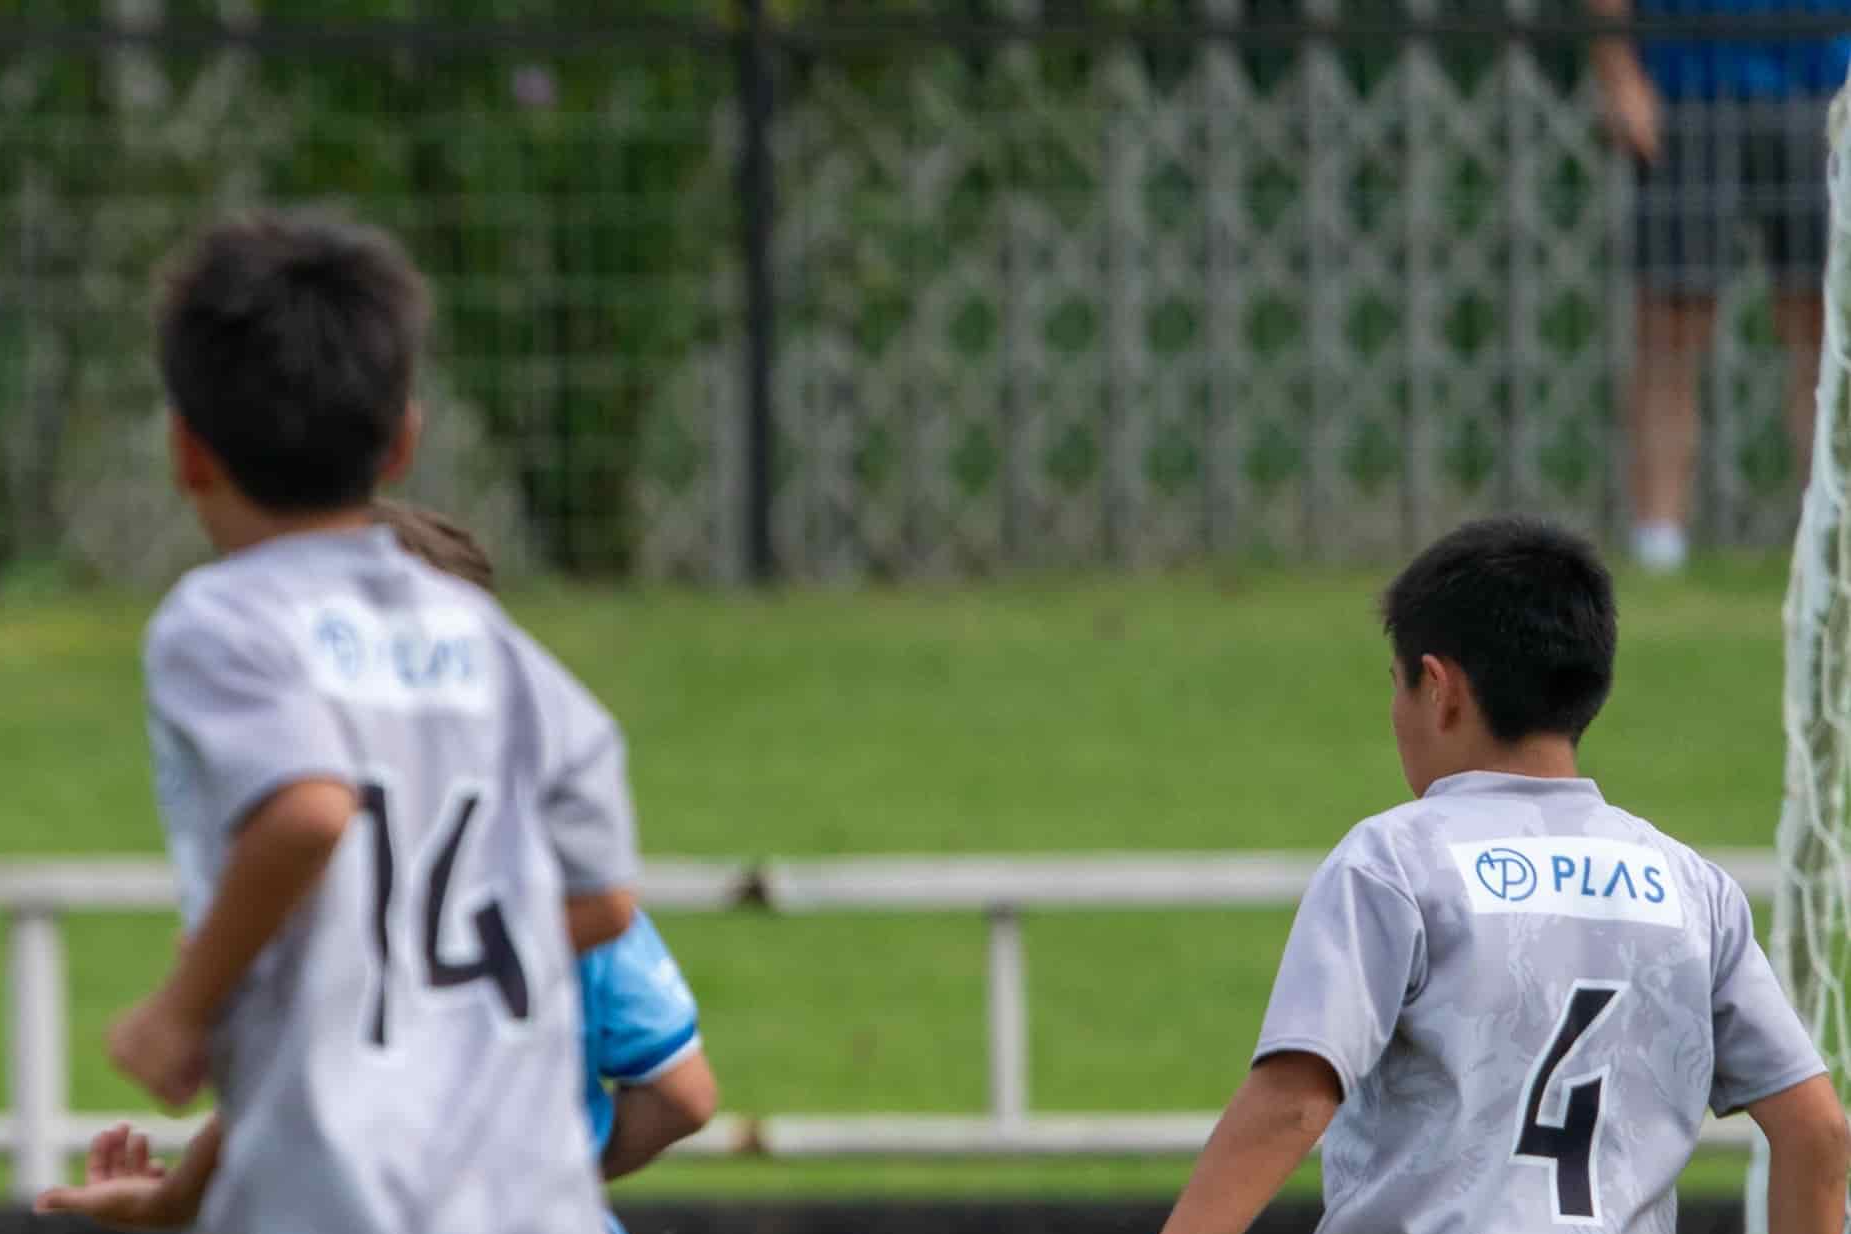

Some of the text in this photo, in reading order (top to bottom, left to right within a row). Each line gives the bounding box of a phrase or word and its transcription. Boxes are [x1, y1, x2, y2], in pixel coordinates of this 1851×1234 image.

[357, 774, 534, 1050] 14
[1551, 854, 1667, 904] PLAS
[1510, 977, 1632, 1227] 4
